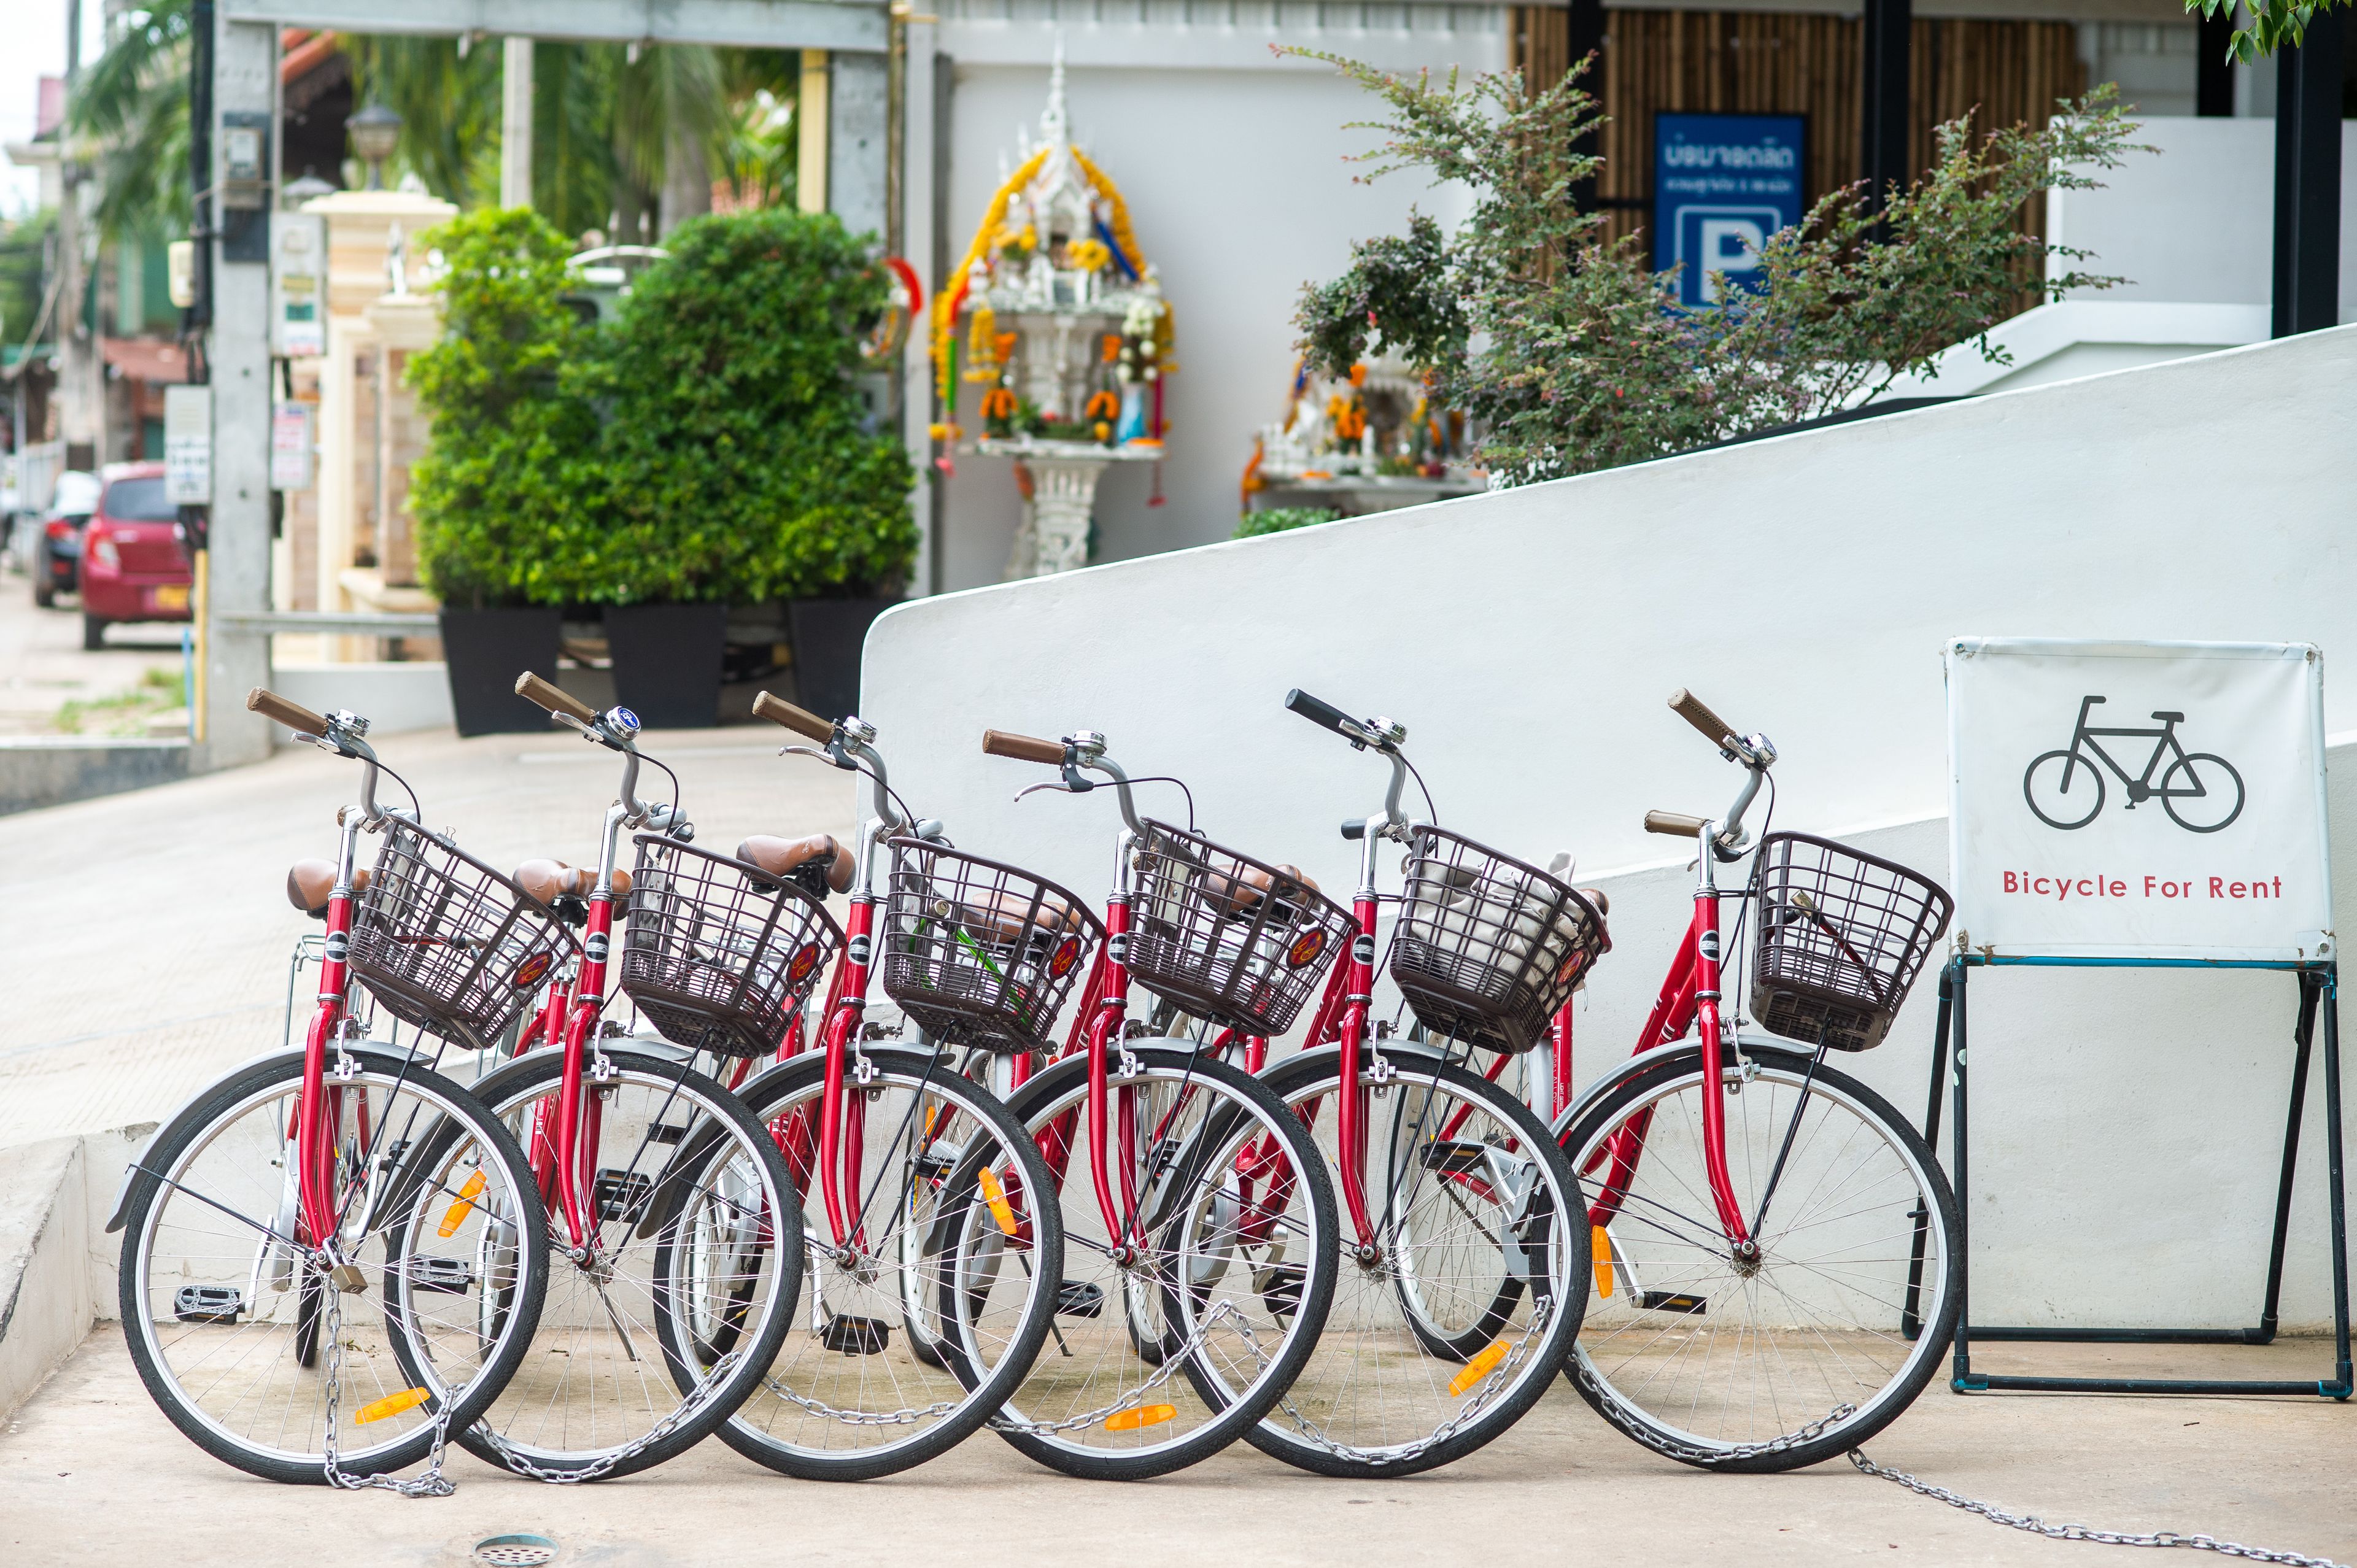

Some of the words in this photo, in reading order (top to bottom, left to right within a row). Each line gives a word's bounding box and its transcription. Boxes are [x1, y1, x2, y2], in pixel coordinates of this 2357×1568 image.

[1700, 218, 1765, 303] P
[2003, 870, 2127, 901] Bicycle
[2144, 875, 2193, 898] For
[2208, 875, 2282, 898] Rent
